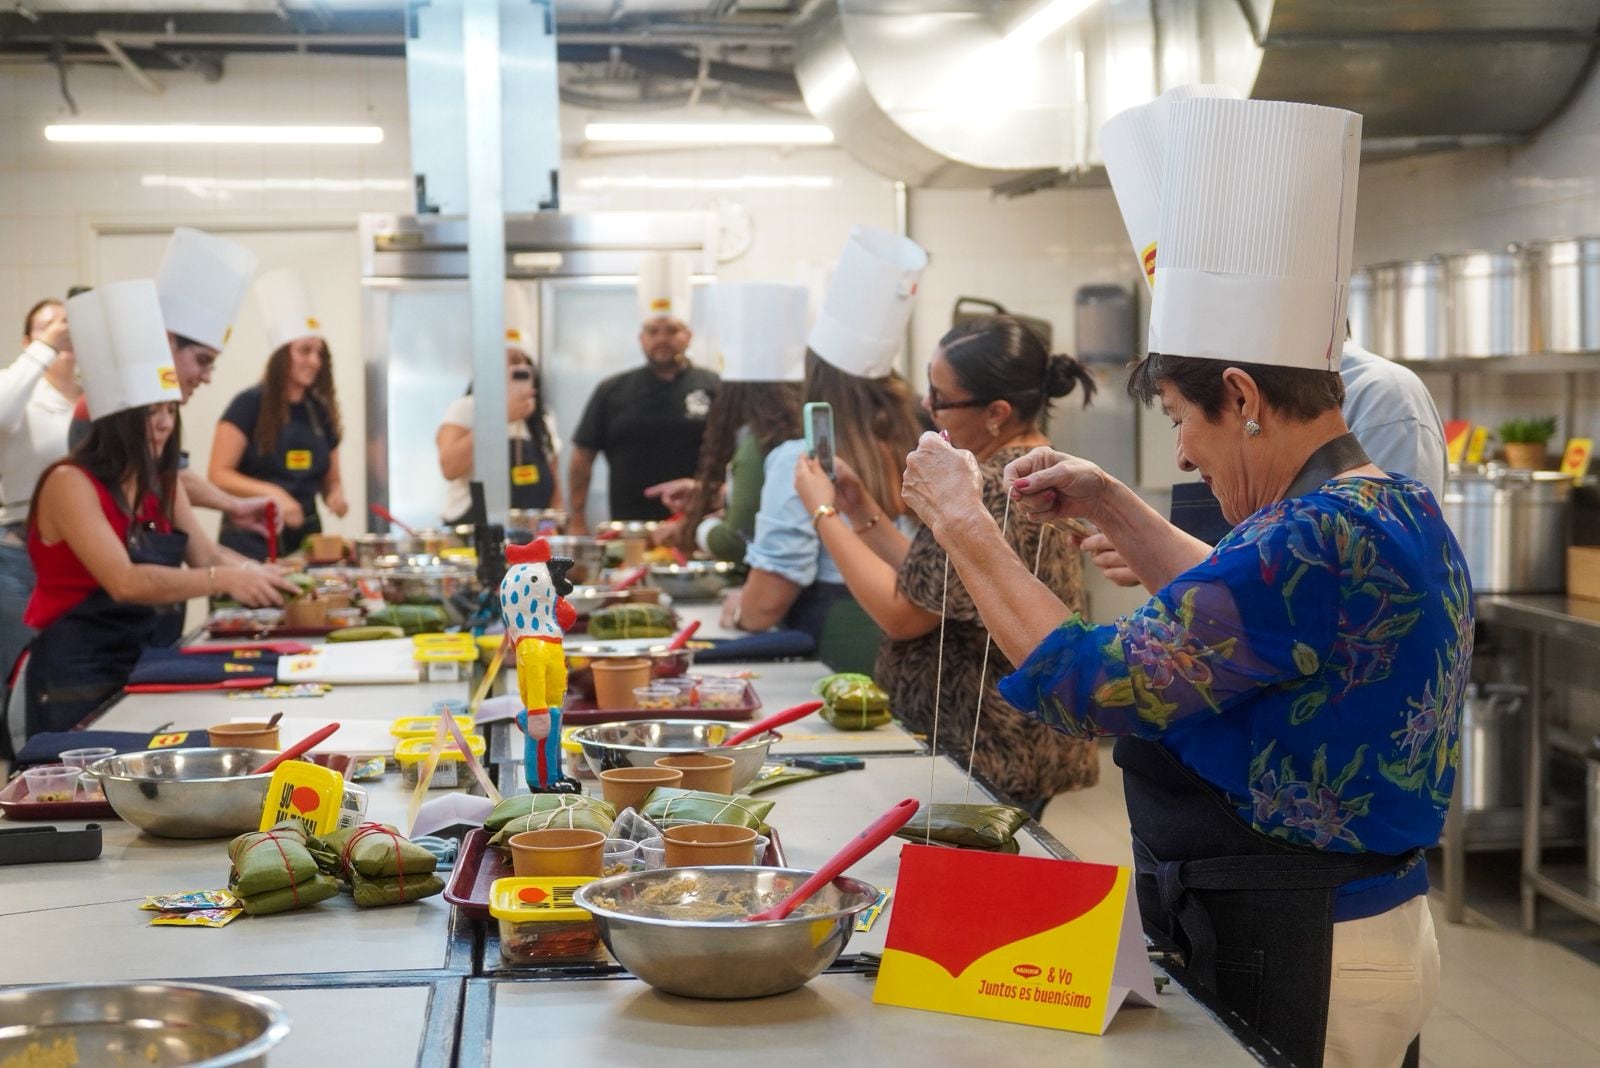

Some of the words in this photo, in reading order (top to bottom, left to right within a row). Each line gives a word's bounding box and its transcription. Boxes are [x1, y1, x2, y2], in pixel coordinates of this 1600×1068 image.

[1047, 967, 1055, 983] &
[1059, 968, 1072, 985] Yo
[978, 980, 1017, 999] Juntos
[1019, 986, 1032, 1000] es
[1033, 986, 1092, 1009] buenísimo
